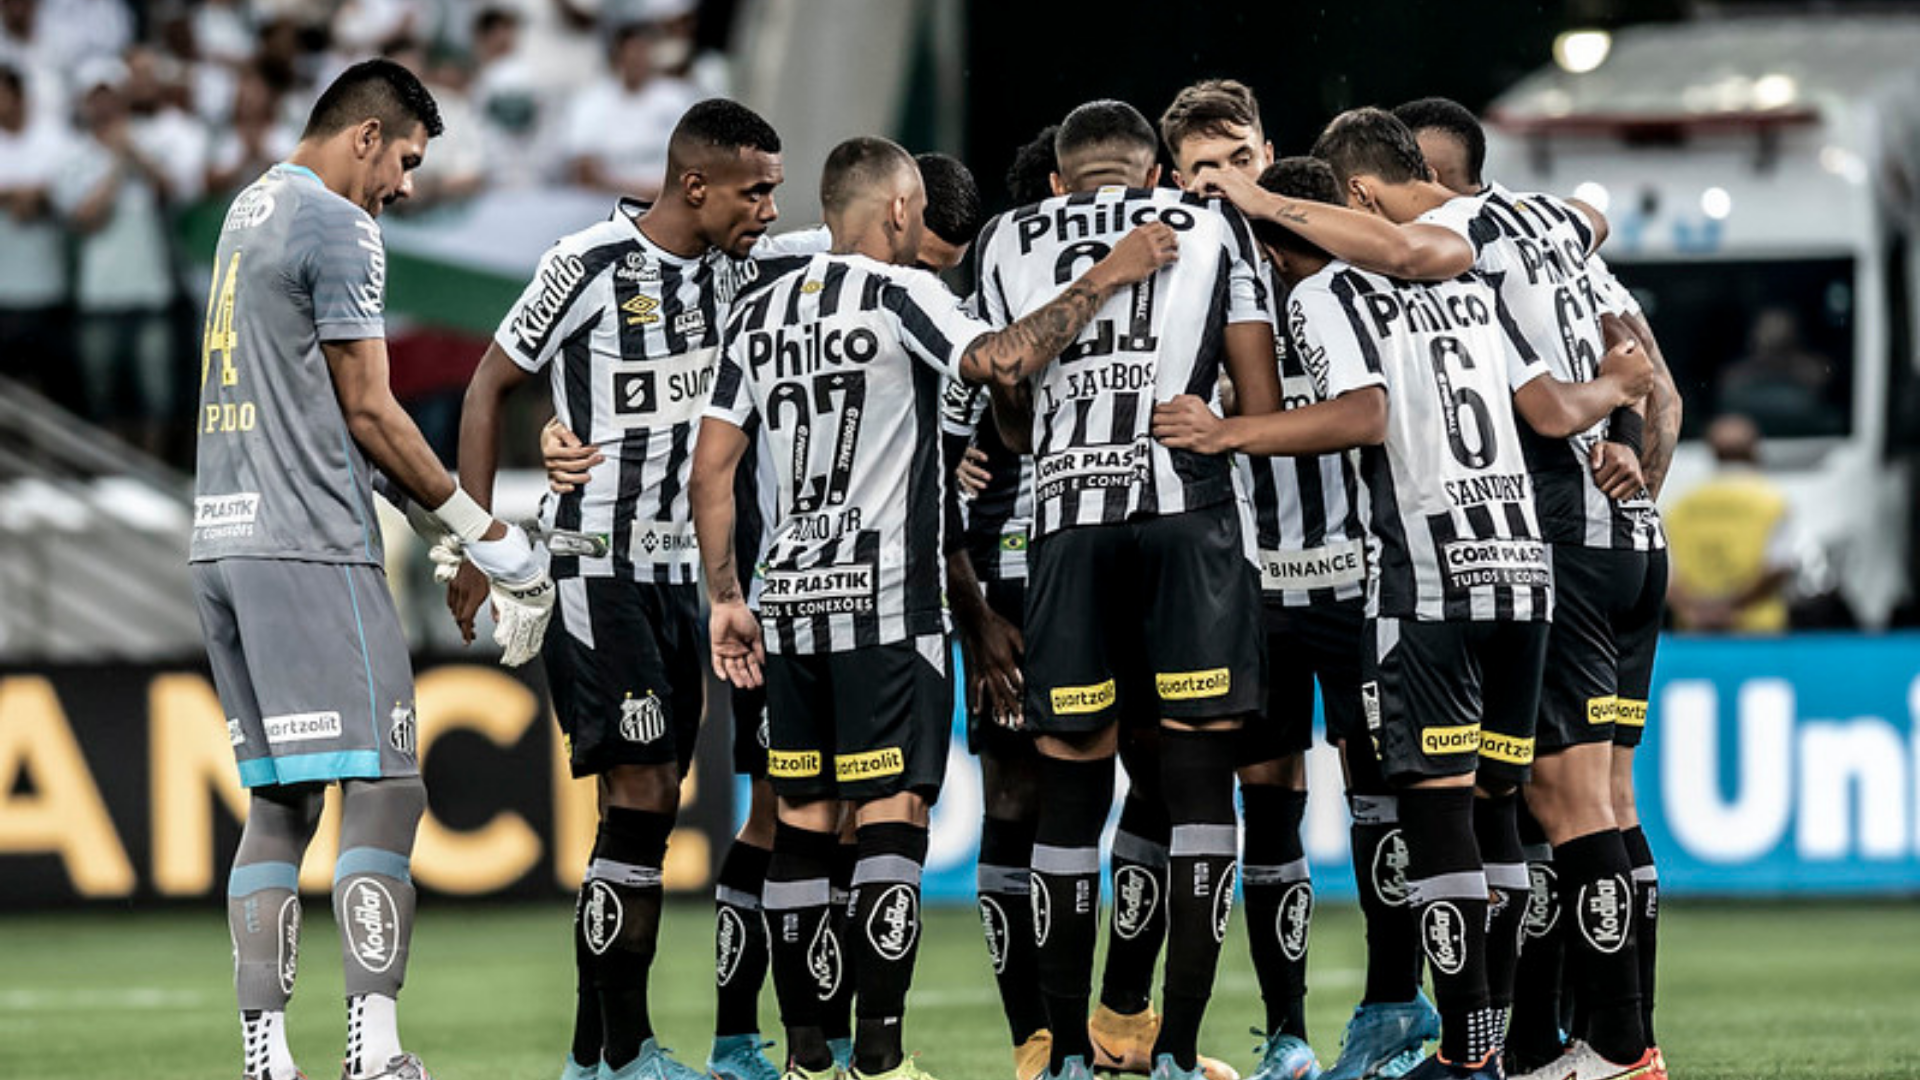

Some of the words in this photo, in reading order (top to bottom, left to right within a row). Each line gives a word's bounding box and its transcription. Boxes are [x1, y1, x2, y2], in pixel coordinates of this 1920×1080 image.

[1018, 202, 1196, 256] Philco
[354, 219, 385, 315] Kicald
[509, 253, 586, 351] Kicaldo
[749, 321, 879, 382] Philco
[1429, 335, 1498, 470] 6
[766, 369, 867, 515] 27
[1444, 473, 1526, 506] SANDRY
[794, 571, 869, 595] PLASTIK
[1269, 555, 1358, 578] BINANCE
[1450, 546, 1499, 565] CORR
[266, 715, 339, 738] artzolit
[1425, 729, 1480, 752] quart
[769, 753, 819, 771] tzolit
[838, 752, 900, 775] artzolit
[354, 883, 386, 962] Kodilar
[879, 889, 910, 952] Kodilar
[1120, 869, 1144, 930] Kodilar
[1285, 887, 1310, 952] Kodilar
[1590, 878, 1621, 942] Kodilar
[1429, 908, 1458, 966] Kodilar
